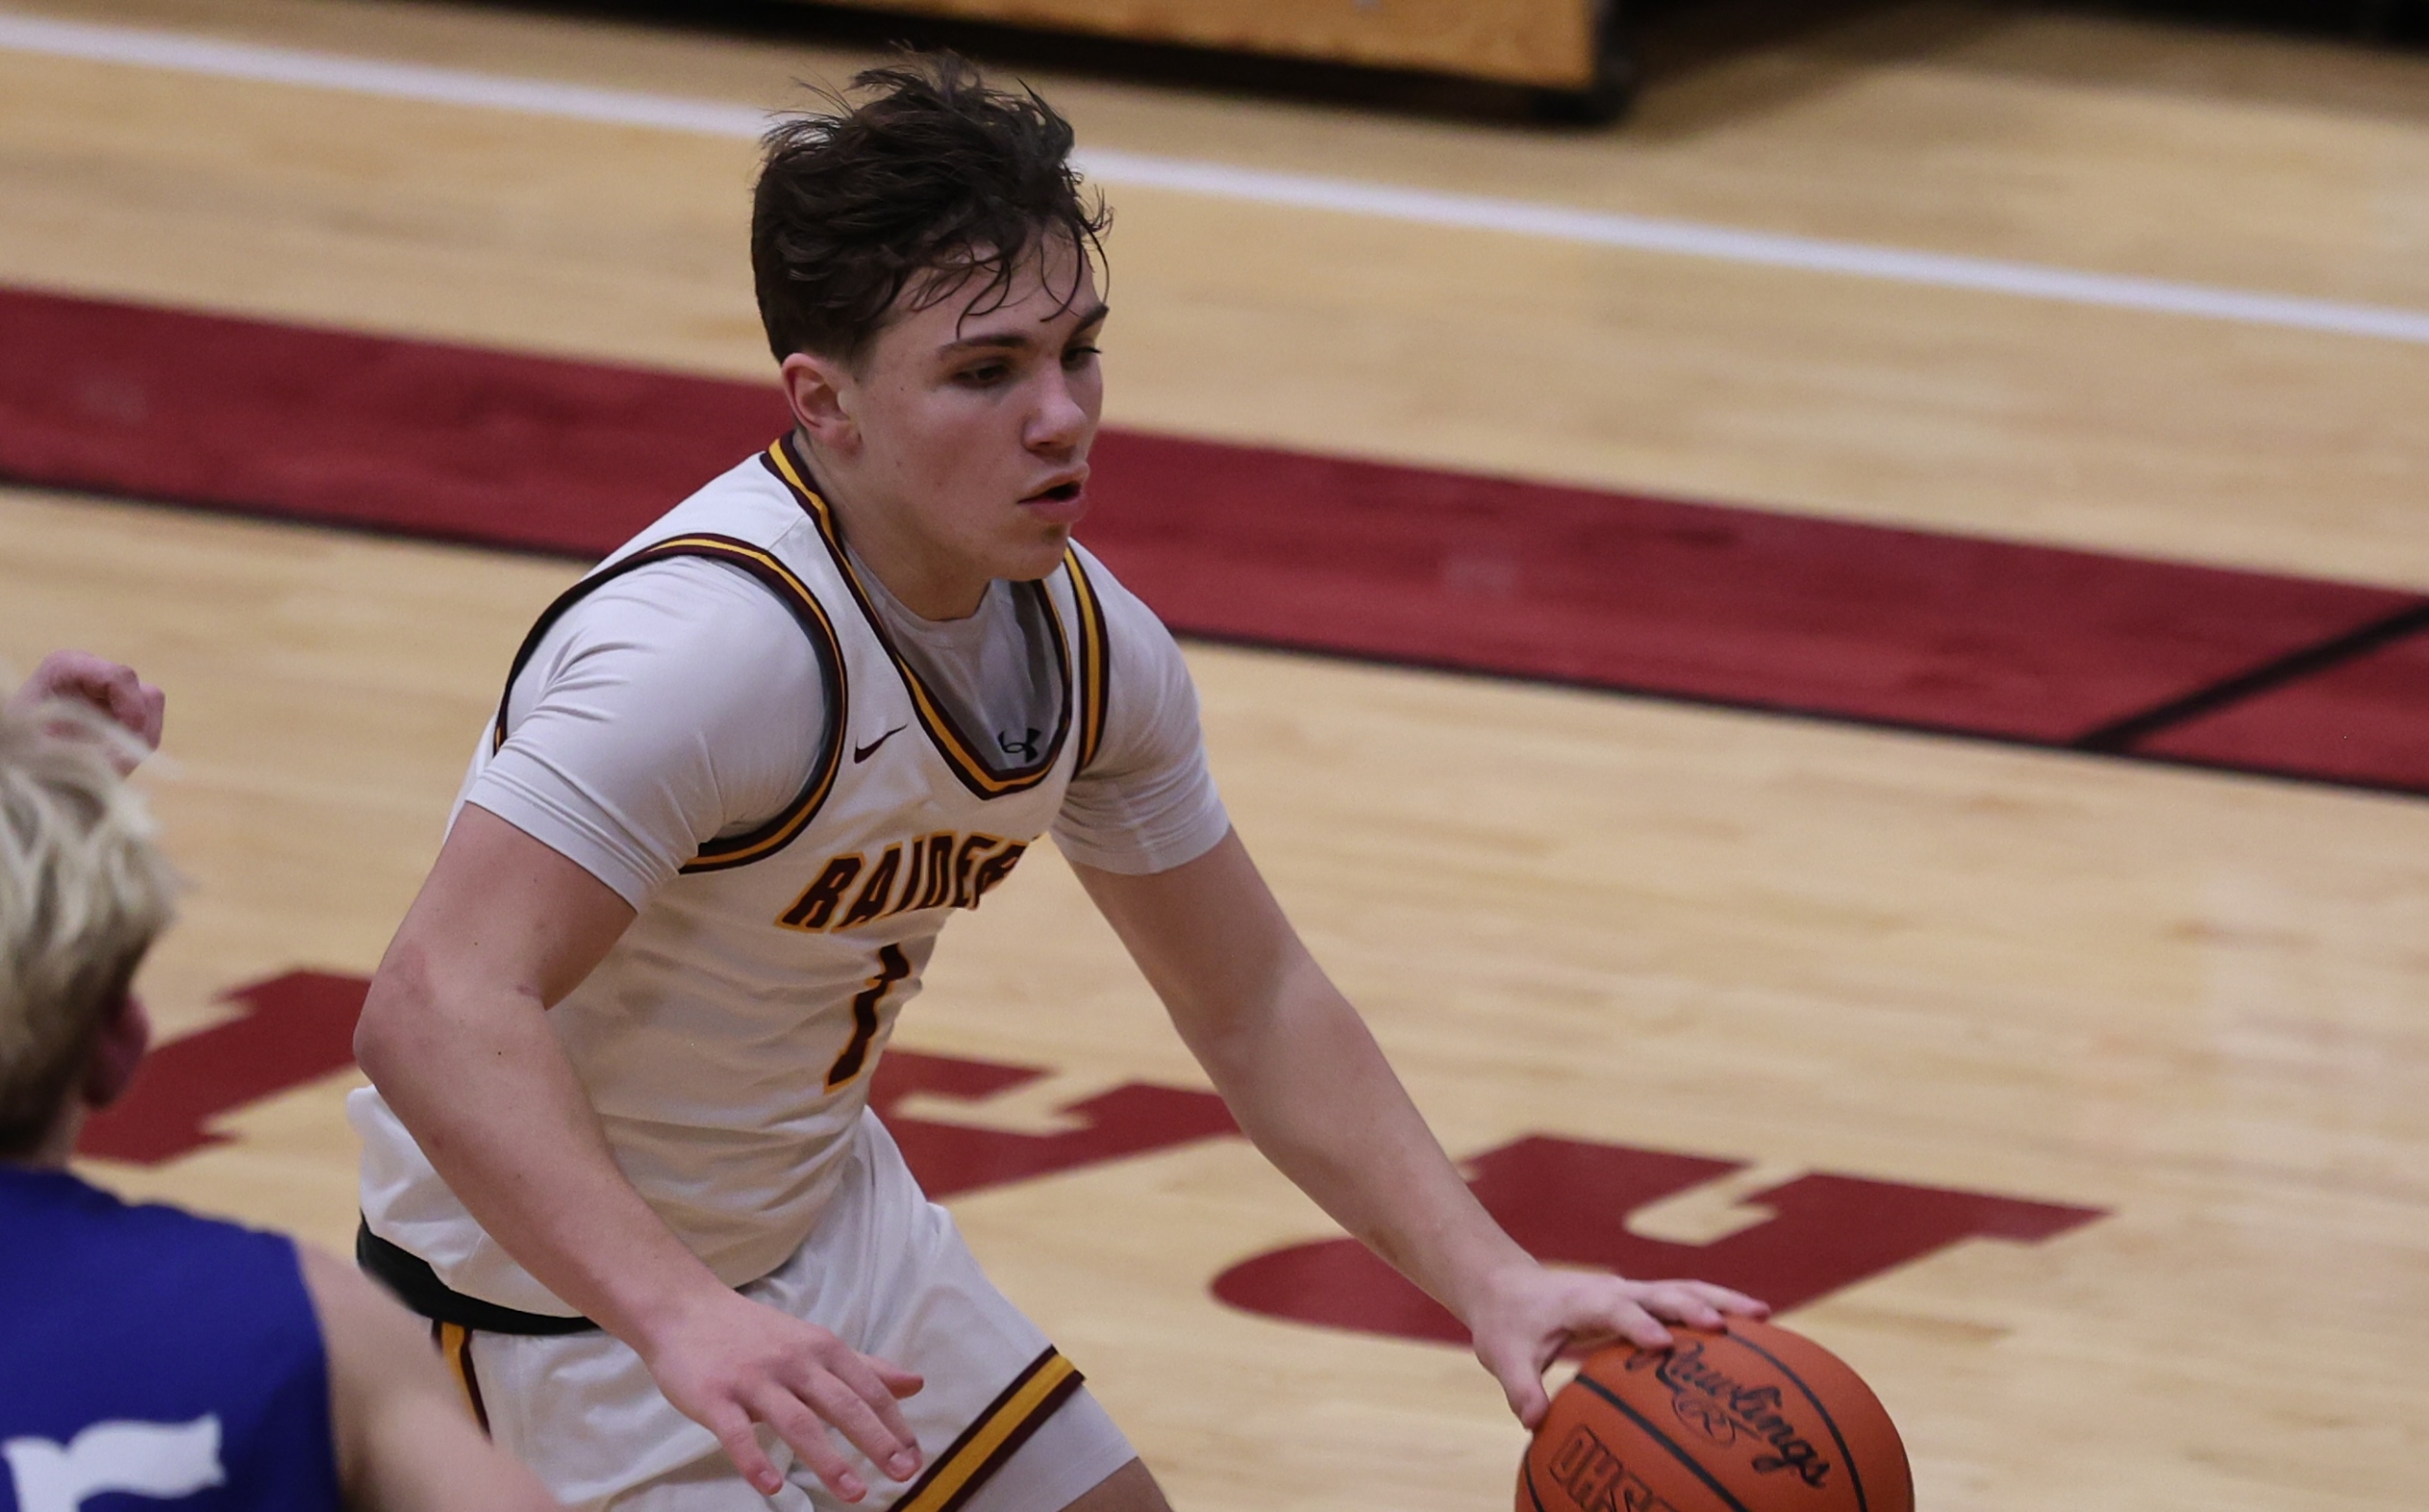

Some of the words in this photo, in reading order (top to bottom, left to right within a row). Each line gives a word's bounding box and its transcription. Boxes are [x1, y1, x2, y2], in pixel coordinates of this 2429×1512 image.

[774, 829, 1041, 933] RAIDER
[824, 942, 911, 1095] 1
[1549, 1425, 1681, 1512] OHS
[1625, 1341, 1830, 1489] Rawlings
